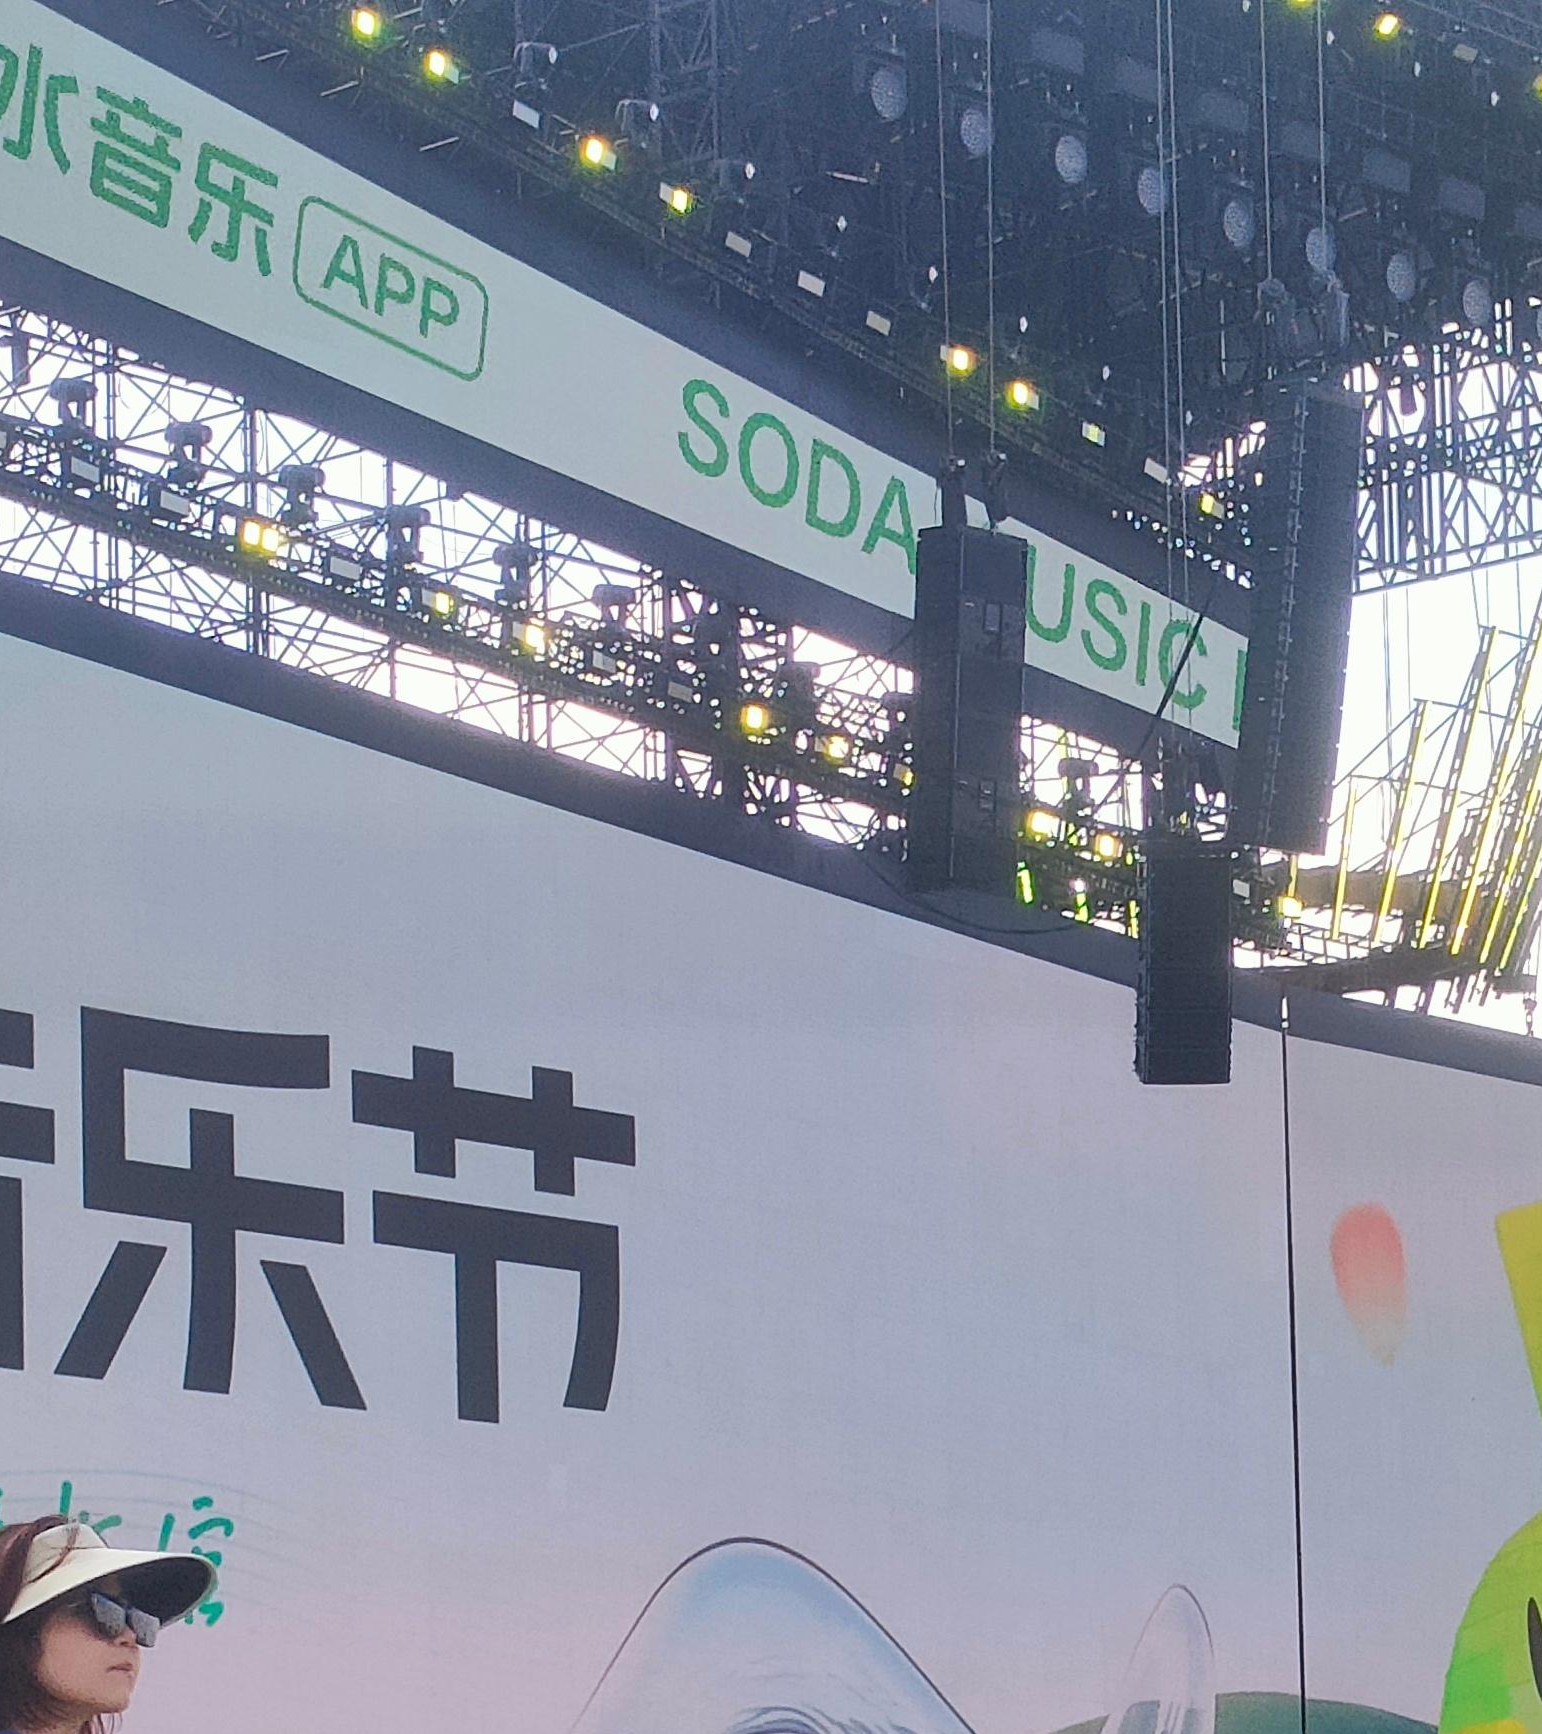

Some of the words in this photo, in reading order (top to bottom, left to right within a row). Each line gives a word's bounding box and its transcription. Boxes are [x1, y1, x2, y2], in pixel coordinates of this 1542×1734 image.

[320, 234, 461, 339] APP
[677, 378, 918, 576] SODA
[1026, 543, 1208, 711] USIC
